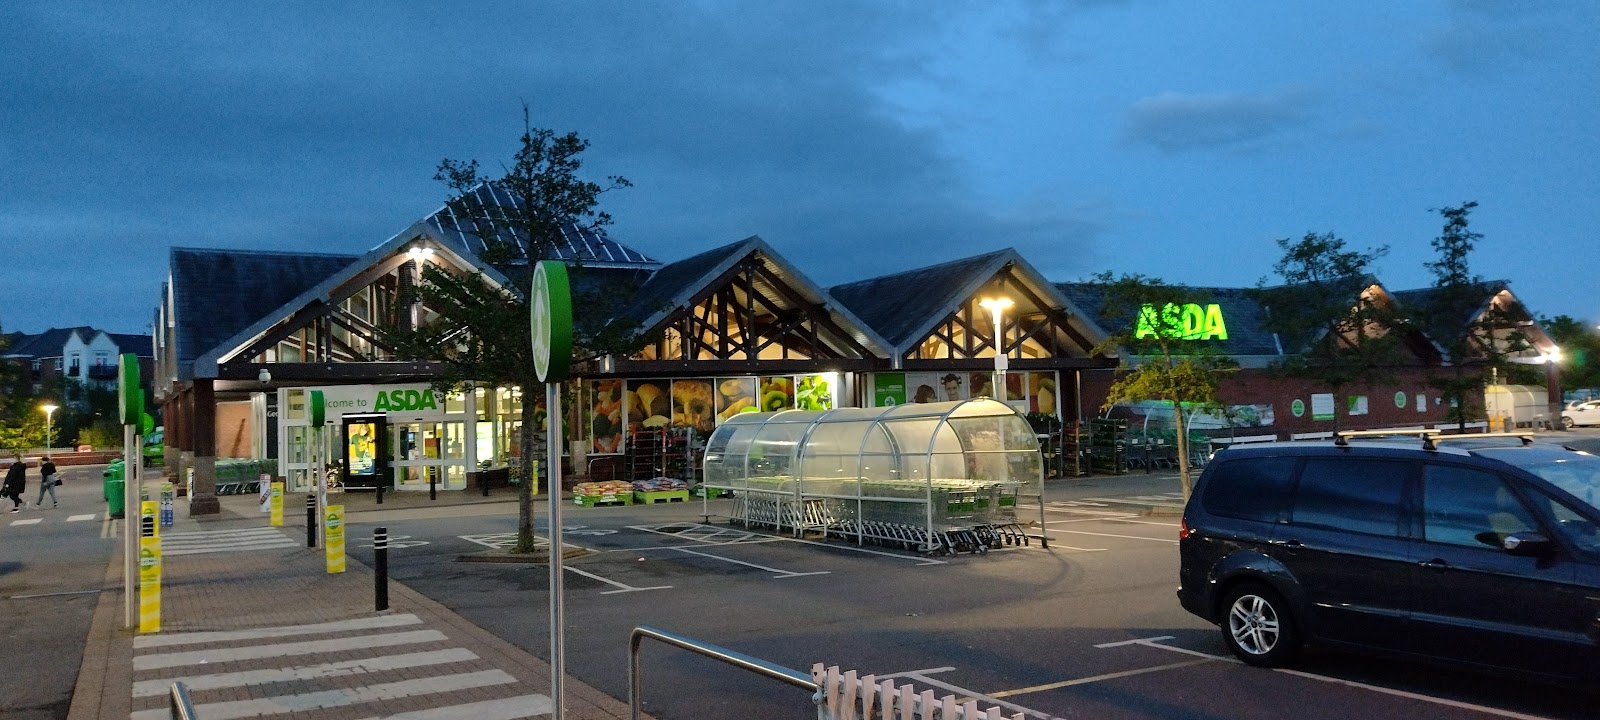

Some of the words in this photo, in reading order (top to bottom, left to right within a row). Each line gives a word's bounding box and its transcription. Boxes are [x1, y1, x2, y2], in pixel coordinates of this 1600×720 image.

[1136, 302, 1228, 340] ASDA
[325, 399, 354, 408] lcome
[357, 399, 368, 407] to
[373, 389, 437, 412] ASDA
